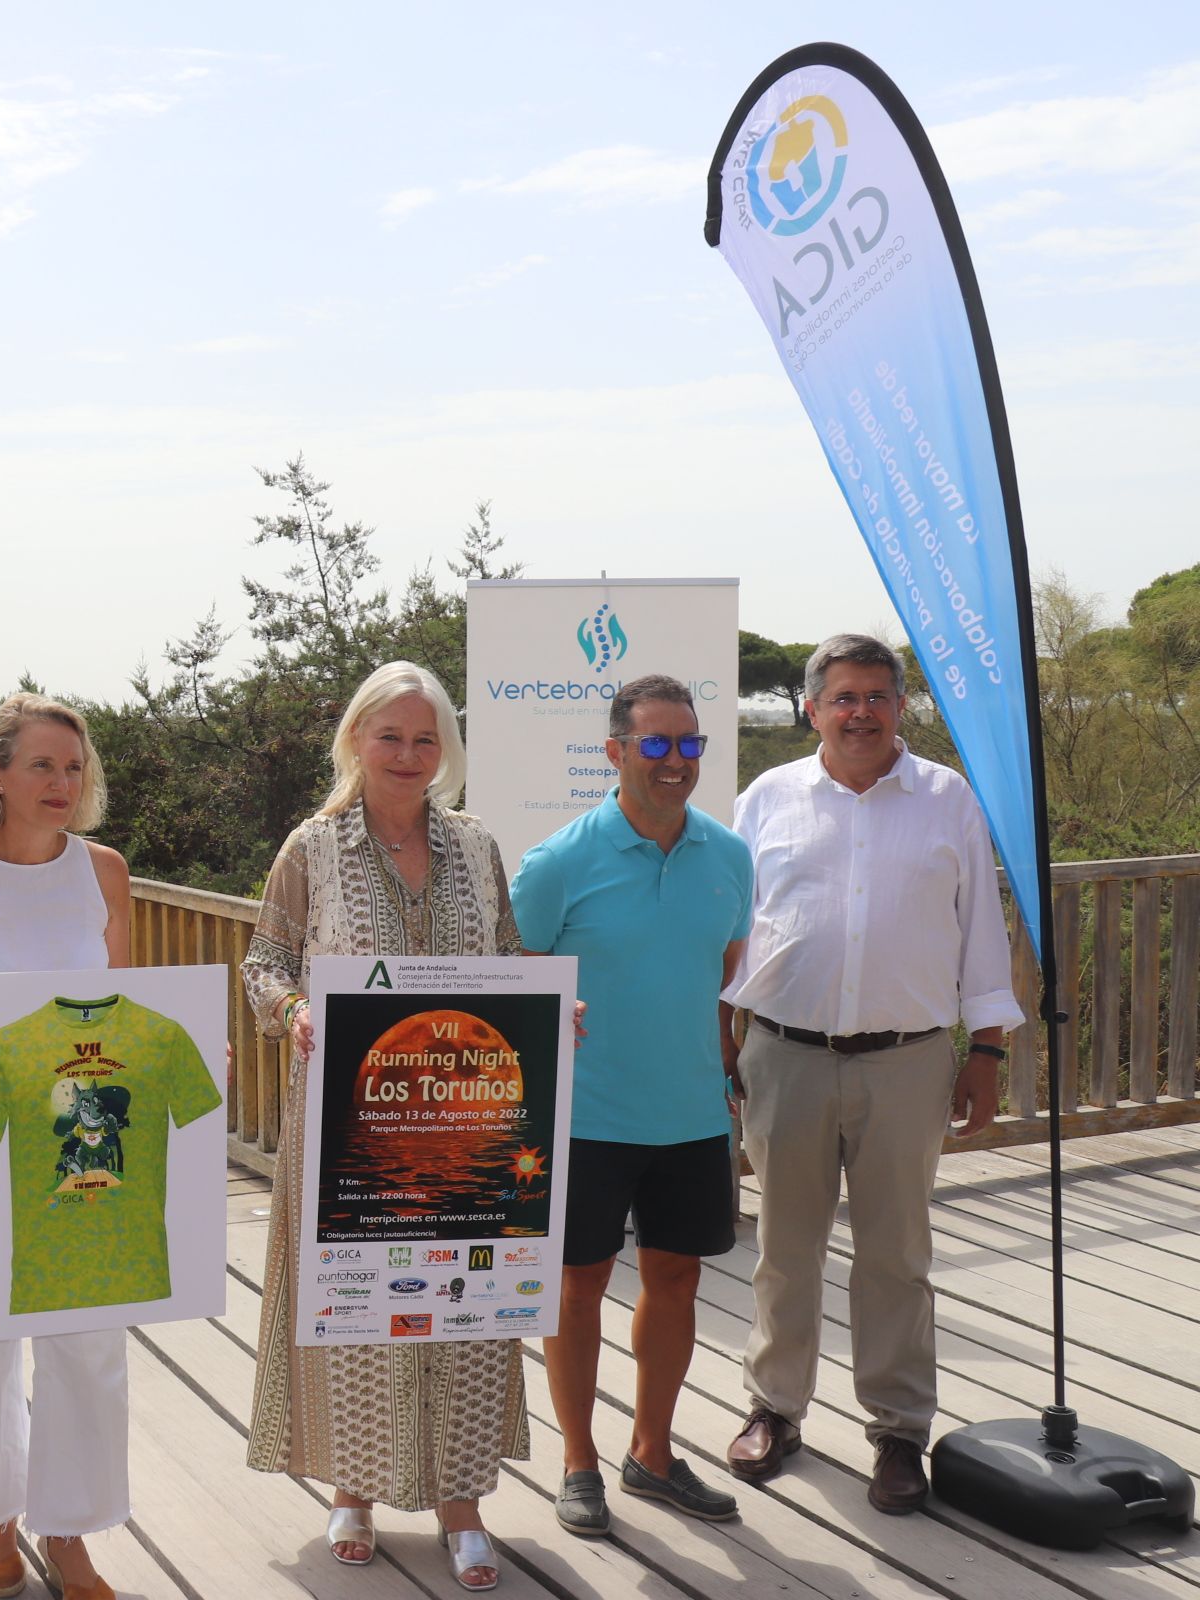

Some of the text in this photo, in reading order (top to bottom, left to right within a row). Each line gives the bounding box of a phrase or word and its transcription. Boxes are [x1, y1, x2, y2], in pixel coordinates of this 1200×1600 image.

[533, 706, 546, 715] Su
[548, 706, 574, 715] salud
[568, 767, 619, 778] Osteopa
[524, 800, 560, 810] Estudio
[426, 964, 457, 972] Andalucía
[432, 1022, 459, 1039] VII
[54, 1057, 92, 1075] RUNNING
[367, 1049, 520, 1072] Running Night
[364, 1074, 519, 1102] Los Toruños
[358, 1108, 528, 1122] Sábado 13 de Agosto de 2022
[370, 1125, 398, 1134] Parque
[399, 1124, 454, 1133] Metropolitano
[481, 1123, 512, 1131] Toruños
[62, 1194, 84, 1204] GICA
[338, 1193, 361, 1201] Salida
[381, 1192, 403, 1200] 22:00
[360, 1214, 422, 1225] Inscripciones
[439, 1212, 506, 1222] www.sesca.es
[326, 1231, 364, 1240] Obligatorio
[337, 1249, 362, 1259] GICA
[317, 1271, 376, 1284] puntohogar
[395, 1280, 419, 1291] Ford
